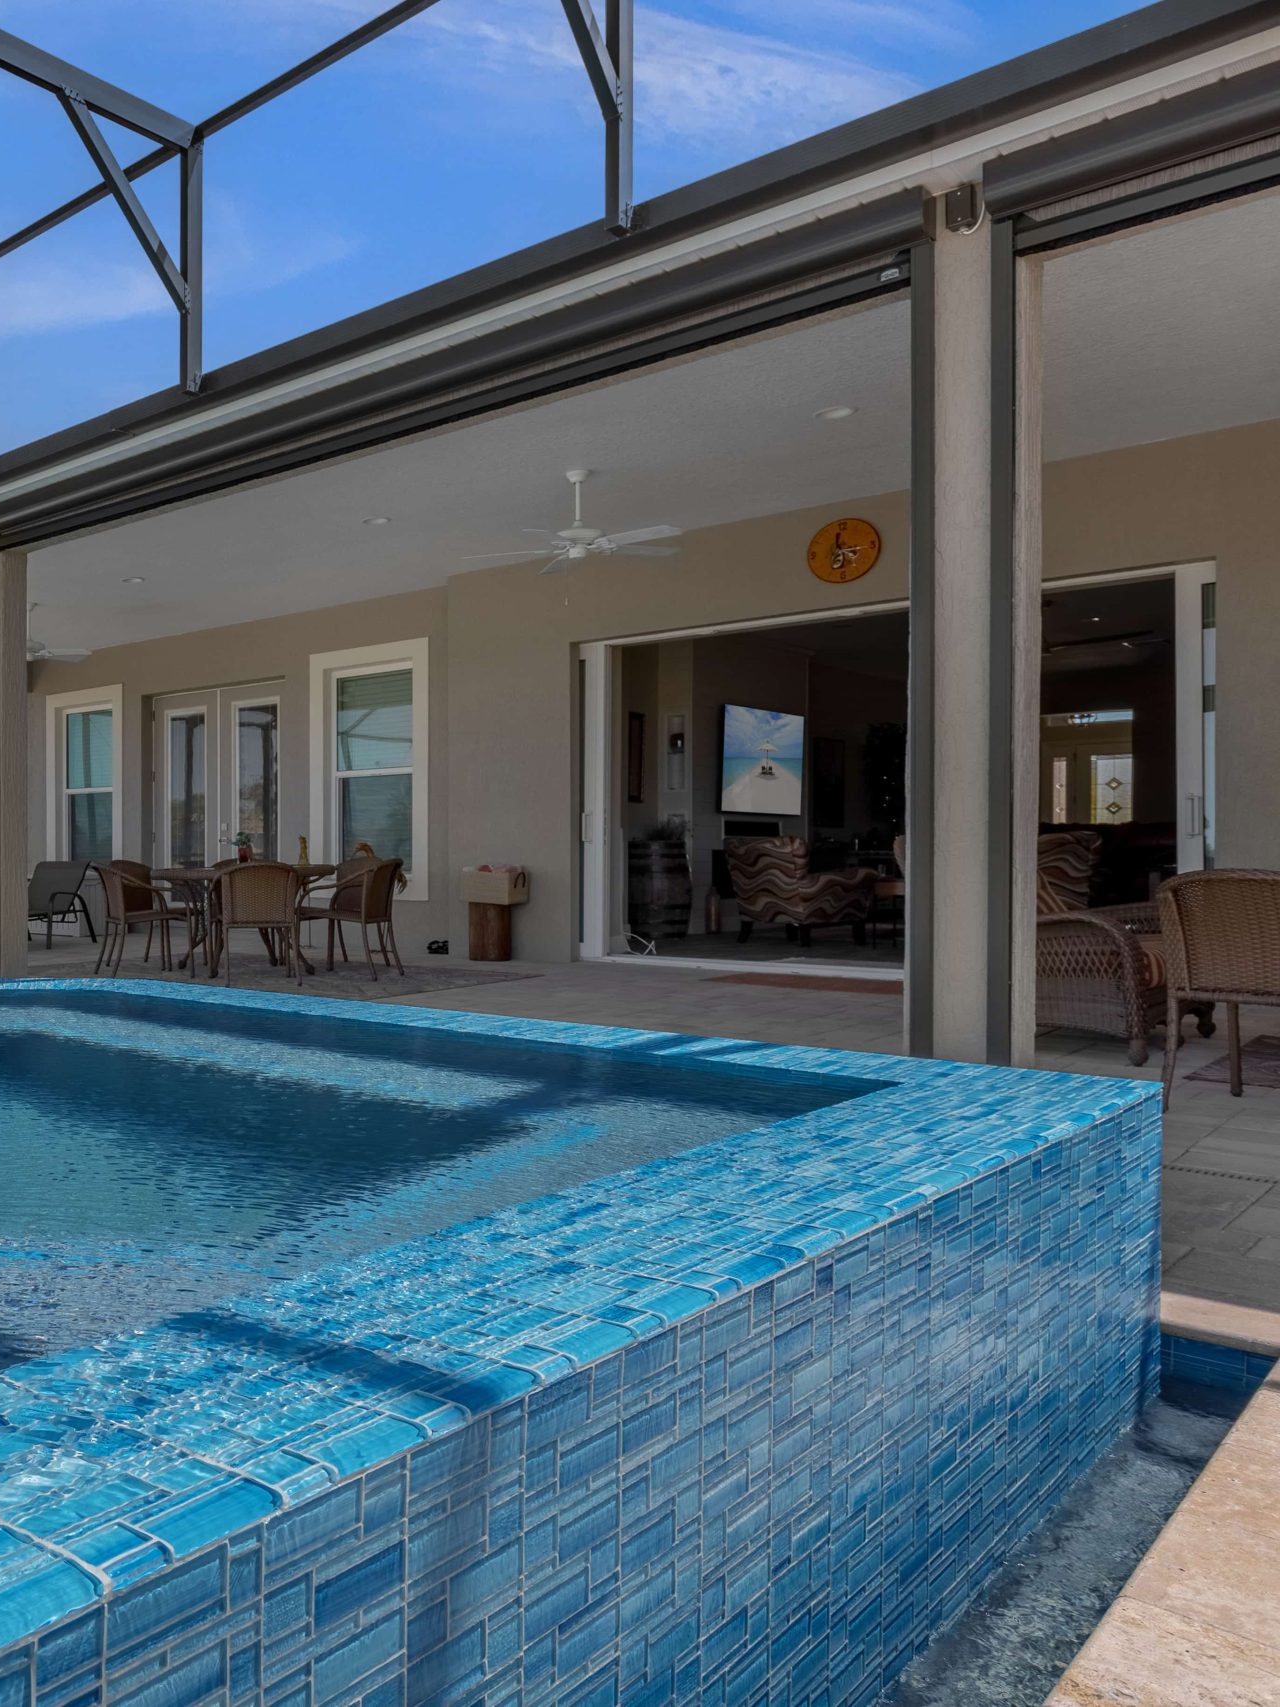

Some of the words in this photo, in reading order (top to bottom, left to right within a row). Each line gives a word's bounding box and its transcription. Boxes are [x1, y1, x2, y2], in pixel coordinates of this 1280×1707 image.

[838, 521, 848, 531] 12
[870, 540, 876, 549] 3
[810, 551, 817, 560] 9
[840, 571, 846, 580] 6
